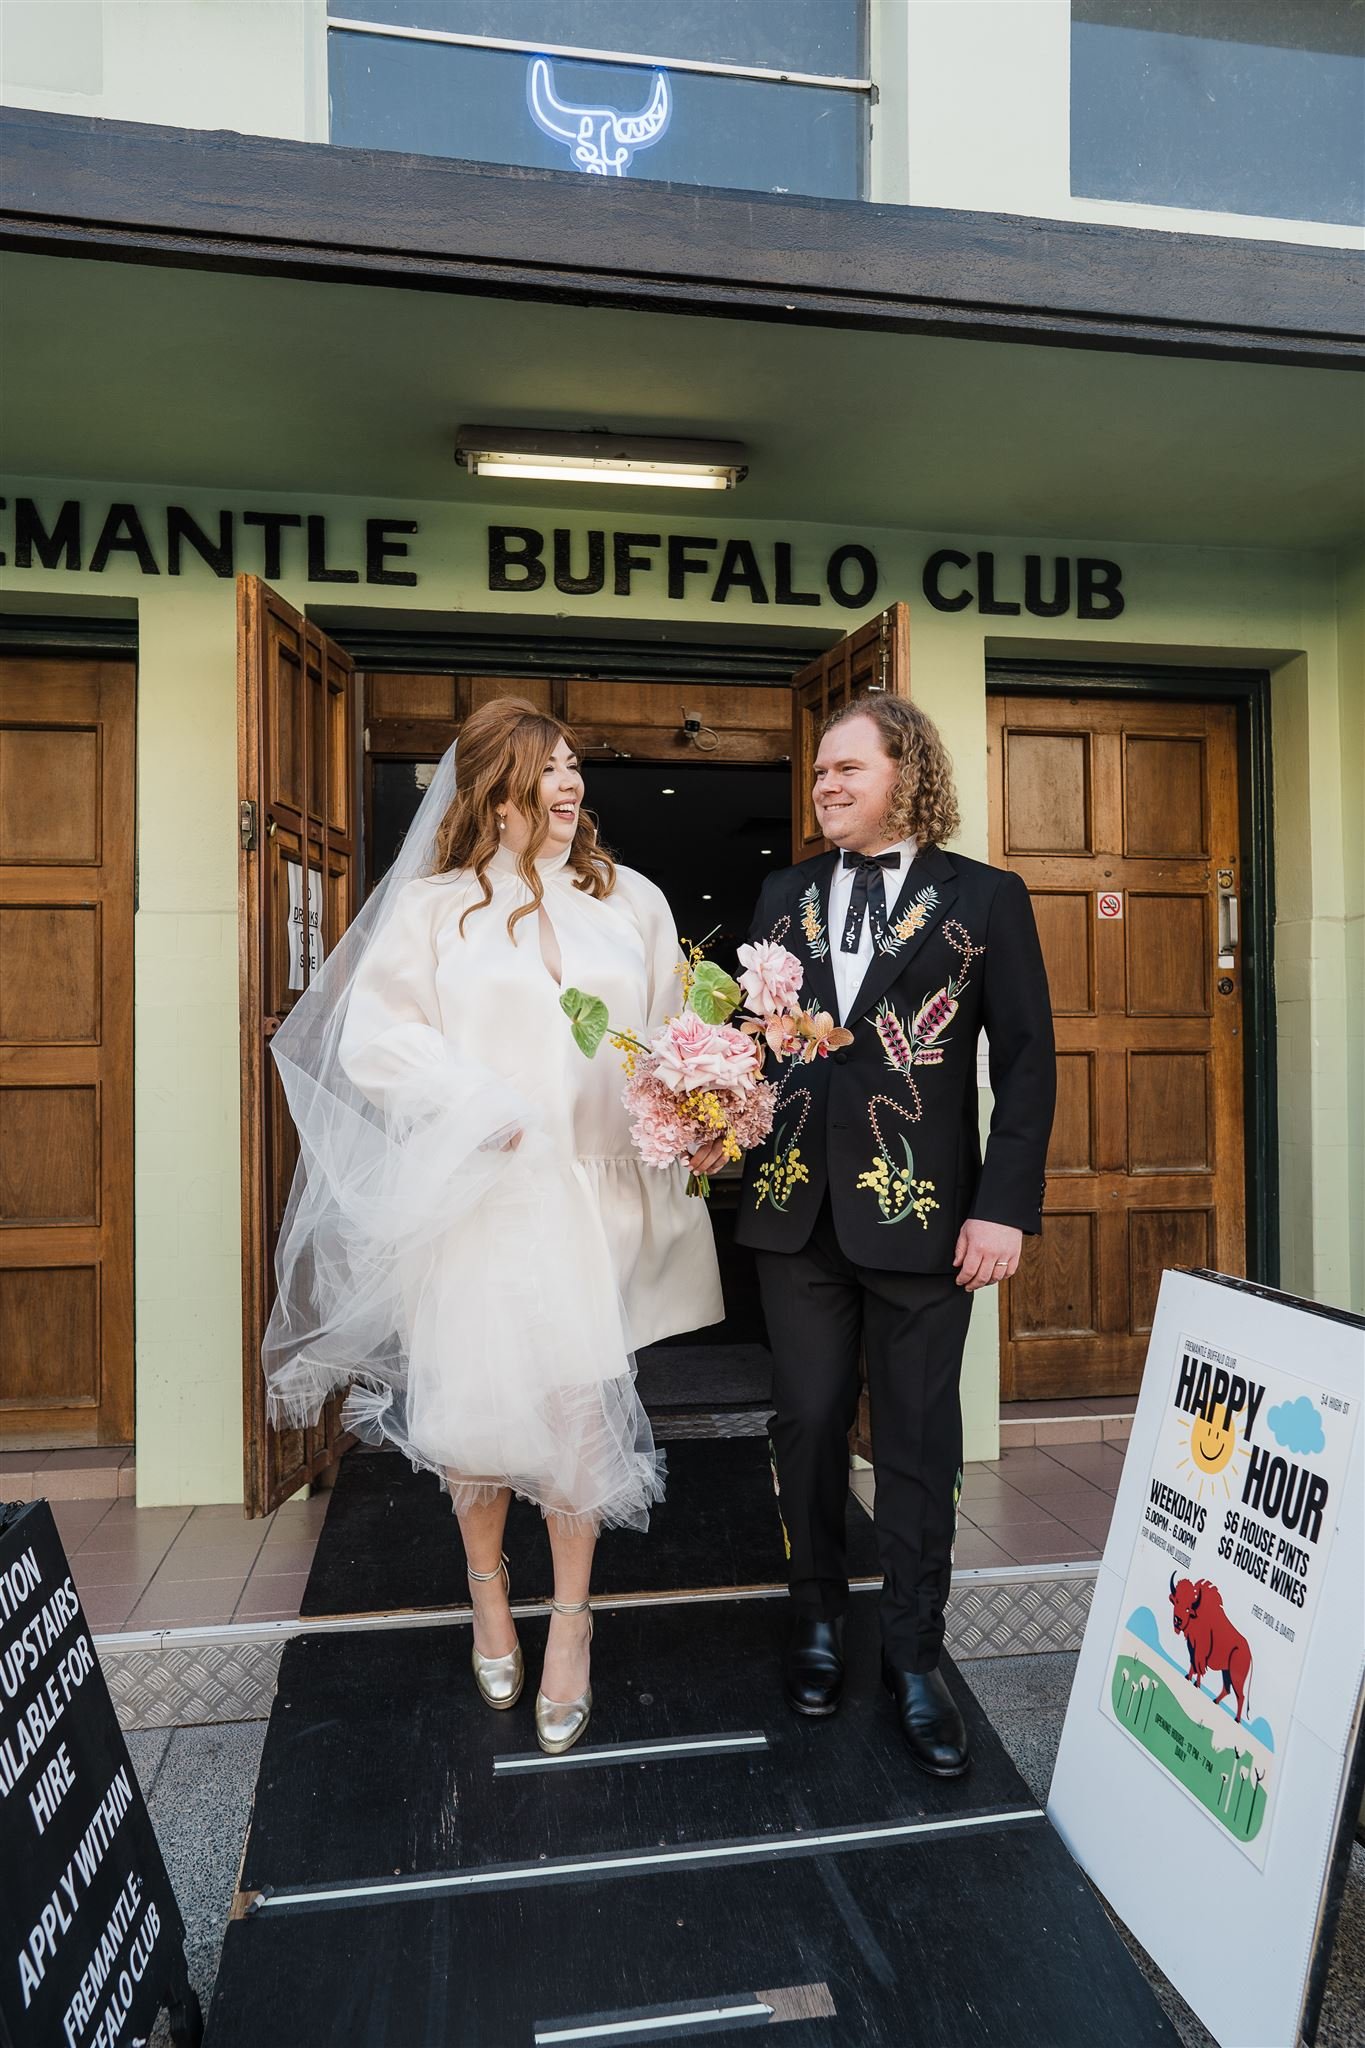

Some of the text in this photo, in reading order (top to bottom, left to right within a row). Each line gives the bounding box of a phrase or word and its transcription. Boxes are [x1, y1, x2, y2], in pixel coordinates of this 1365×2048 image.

[0, 497, 1125, 620] MANTLE BUFFALO CLUB
[1174, 1354, 1266, 1442] HAPPY
[1145, 1507, 1170, 1533] 5.00PM
[1172, 1524, 1197, 1551] 6.00PM
[1150, 1478, 1207, 1533] WEEKDAYS
[1241, 1444, 1329, 1544] HOUR
[1217, 1535, 1307, 1609] $6 HOUSE WINES
[1224, 1510, 1310, 1578] $6 HOUSE PINTS
[0, 1546, 42, 1631] TION
[1251, 1603, 1264, 1621] FREE
[0, 1577, 79, 1698] UPSTAIRS
[57, 1635, 95, 1702] FOR
[28, 1741, 76, 1836] HIRE
[18, 1764, 133, 2008] APPLY WITHIN
[63, 1870, 141, 2048] FREMANTLE
[129, 1902, 160, 1983] CLUB
